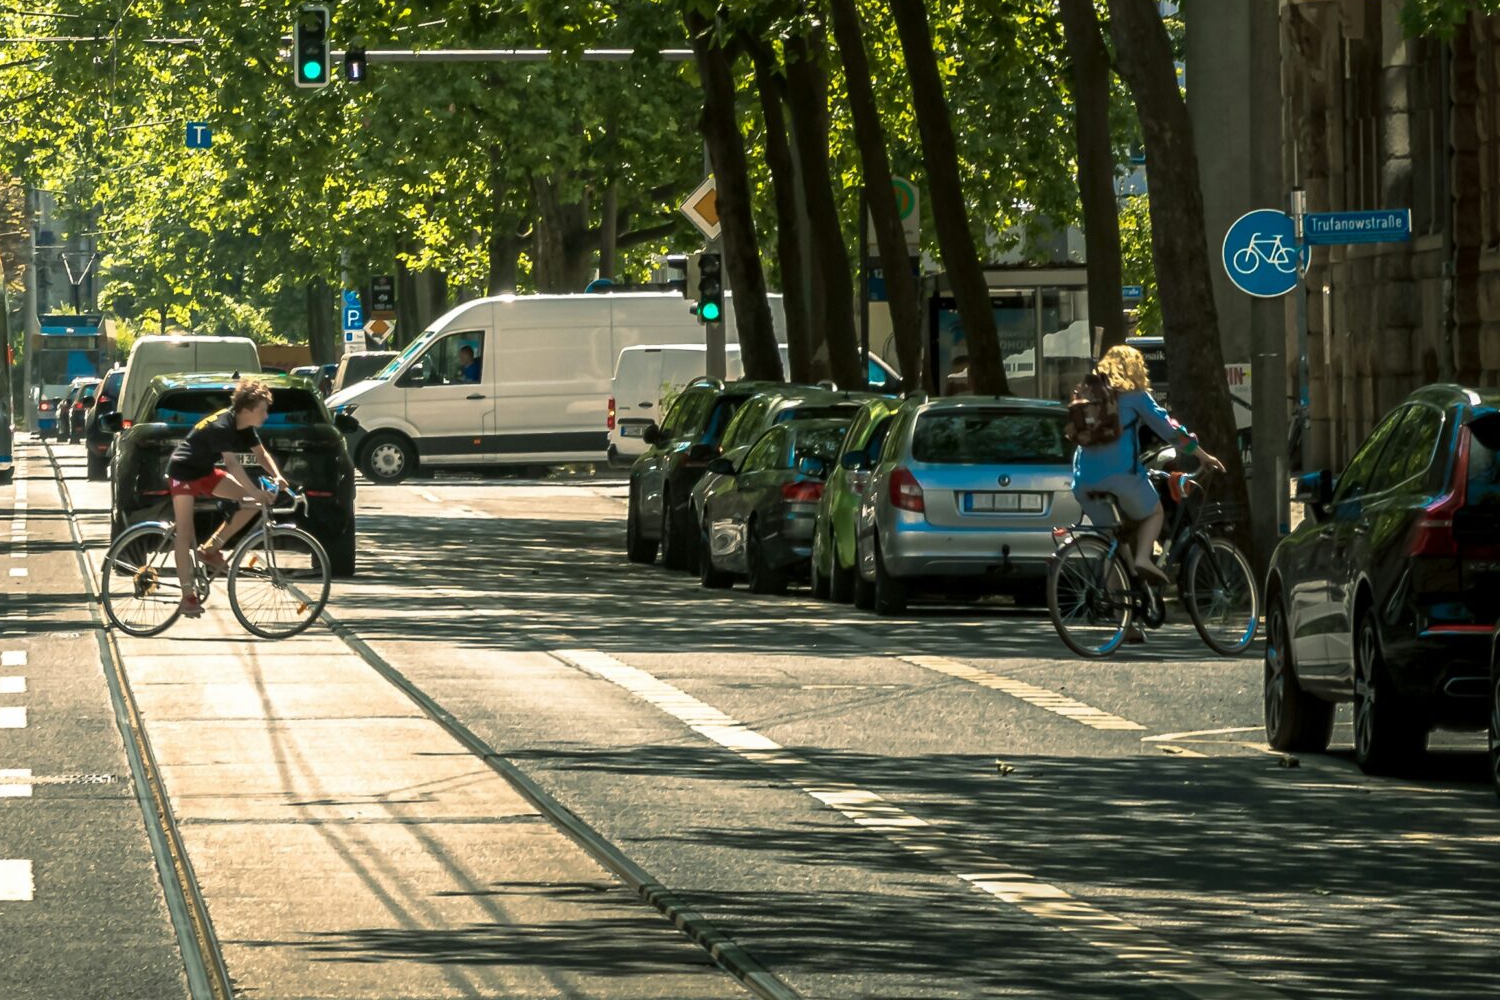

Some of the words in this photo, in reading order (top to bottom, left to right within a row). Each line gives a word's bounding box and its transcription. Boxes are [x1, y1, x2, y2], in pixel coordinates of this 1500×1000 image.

[193, 126, 206, 144] T
[1311, 214, 1402, 231] Trufanowstraße
[348, 310, 359, 327] P
